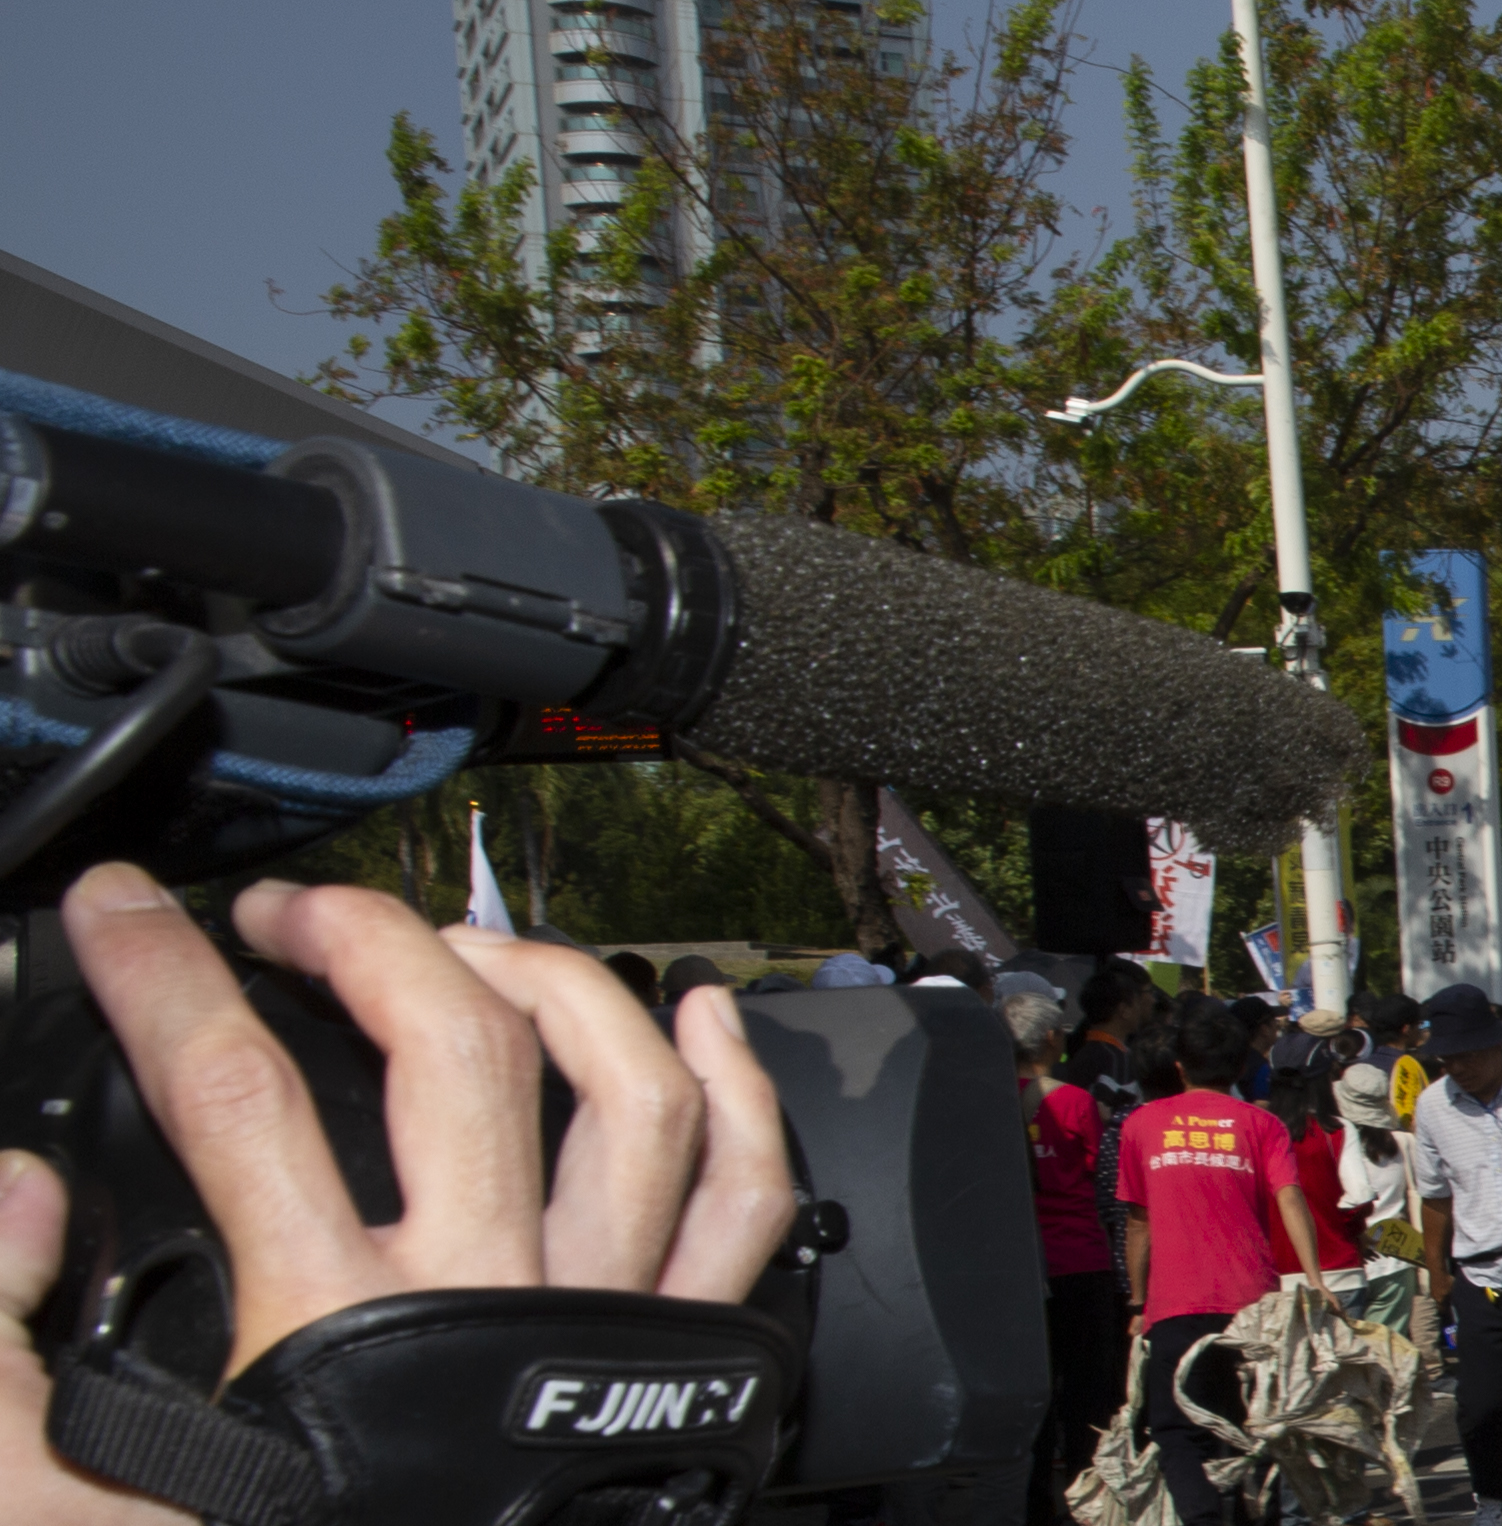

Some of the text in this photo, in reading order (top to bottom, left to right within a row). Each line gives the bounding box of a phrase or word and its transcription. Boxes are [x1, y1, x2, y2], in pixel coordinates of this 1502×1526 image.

[1462, 802, 1474, 824] 1
[1425, 836, 1456, 964] 中央公園站
[1187, 1115, 1235, 1128] Power
[1163, 1130, 1236, 1151] 高思博
